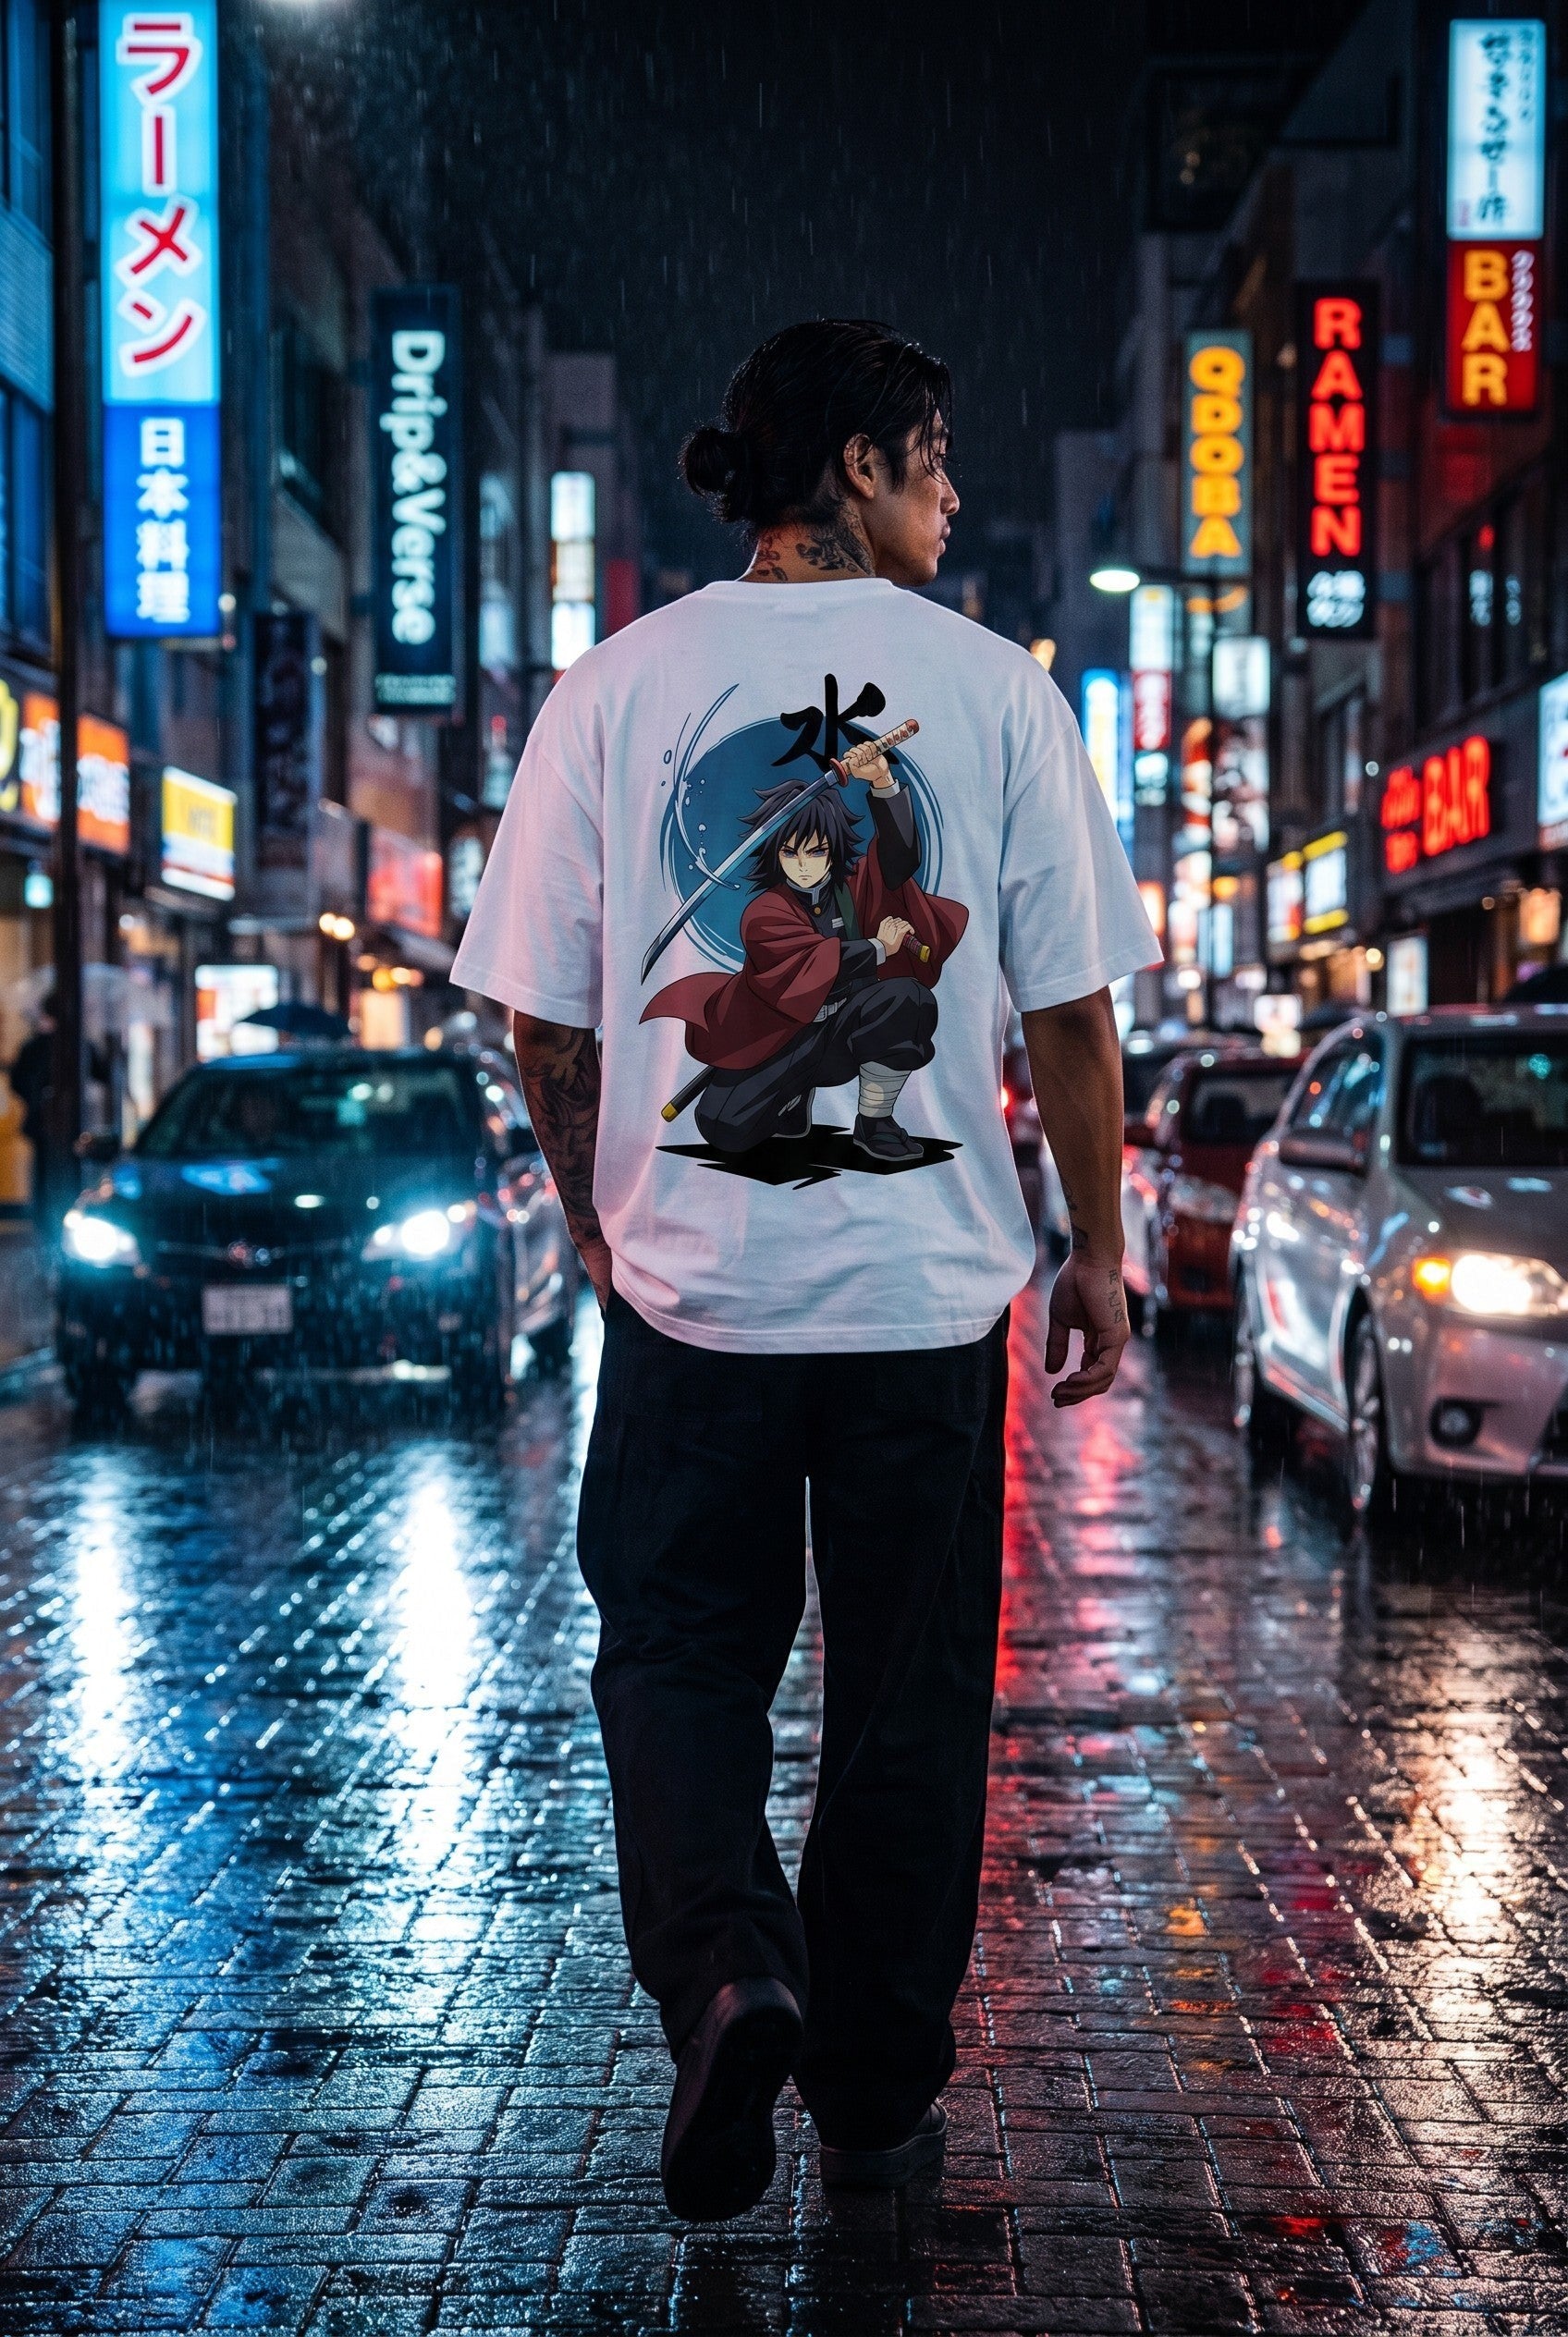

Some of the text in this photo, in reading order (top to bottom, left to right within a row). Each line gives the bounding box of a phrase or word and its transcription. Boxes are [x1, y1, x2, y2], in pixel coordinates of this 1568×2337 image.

[117, 15, 202, 372] ラーメン
[1309, 298, 1365, 557] RAMEN
[1462, 250, 1510, 406] BAR
[137, 418, 190, 623] 日本料理
[380, 330, 447, 644] Drip&Verse
[1190, 346, 1245, 557] QDOBA
[771, 673, 900, 773] 水
[1424, 736, 1489, 856] BAR
